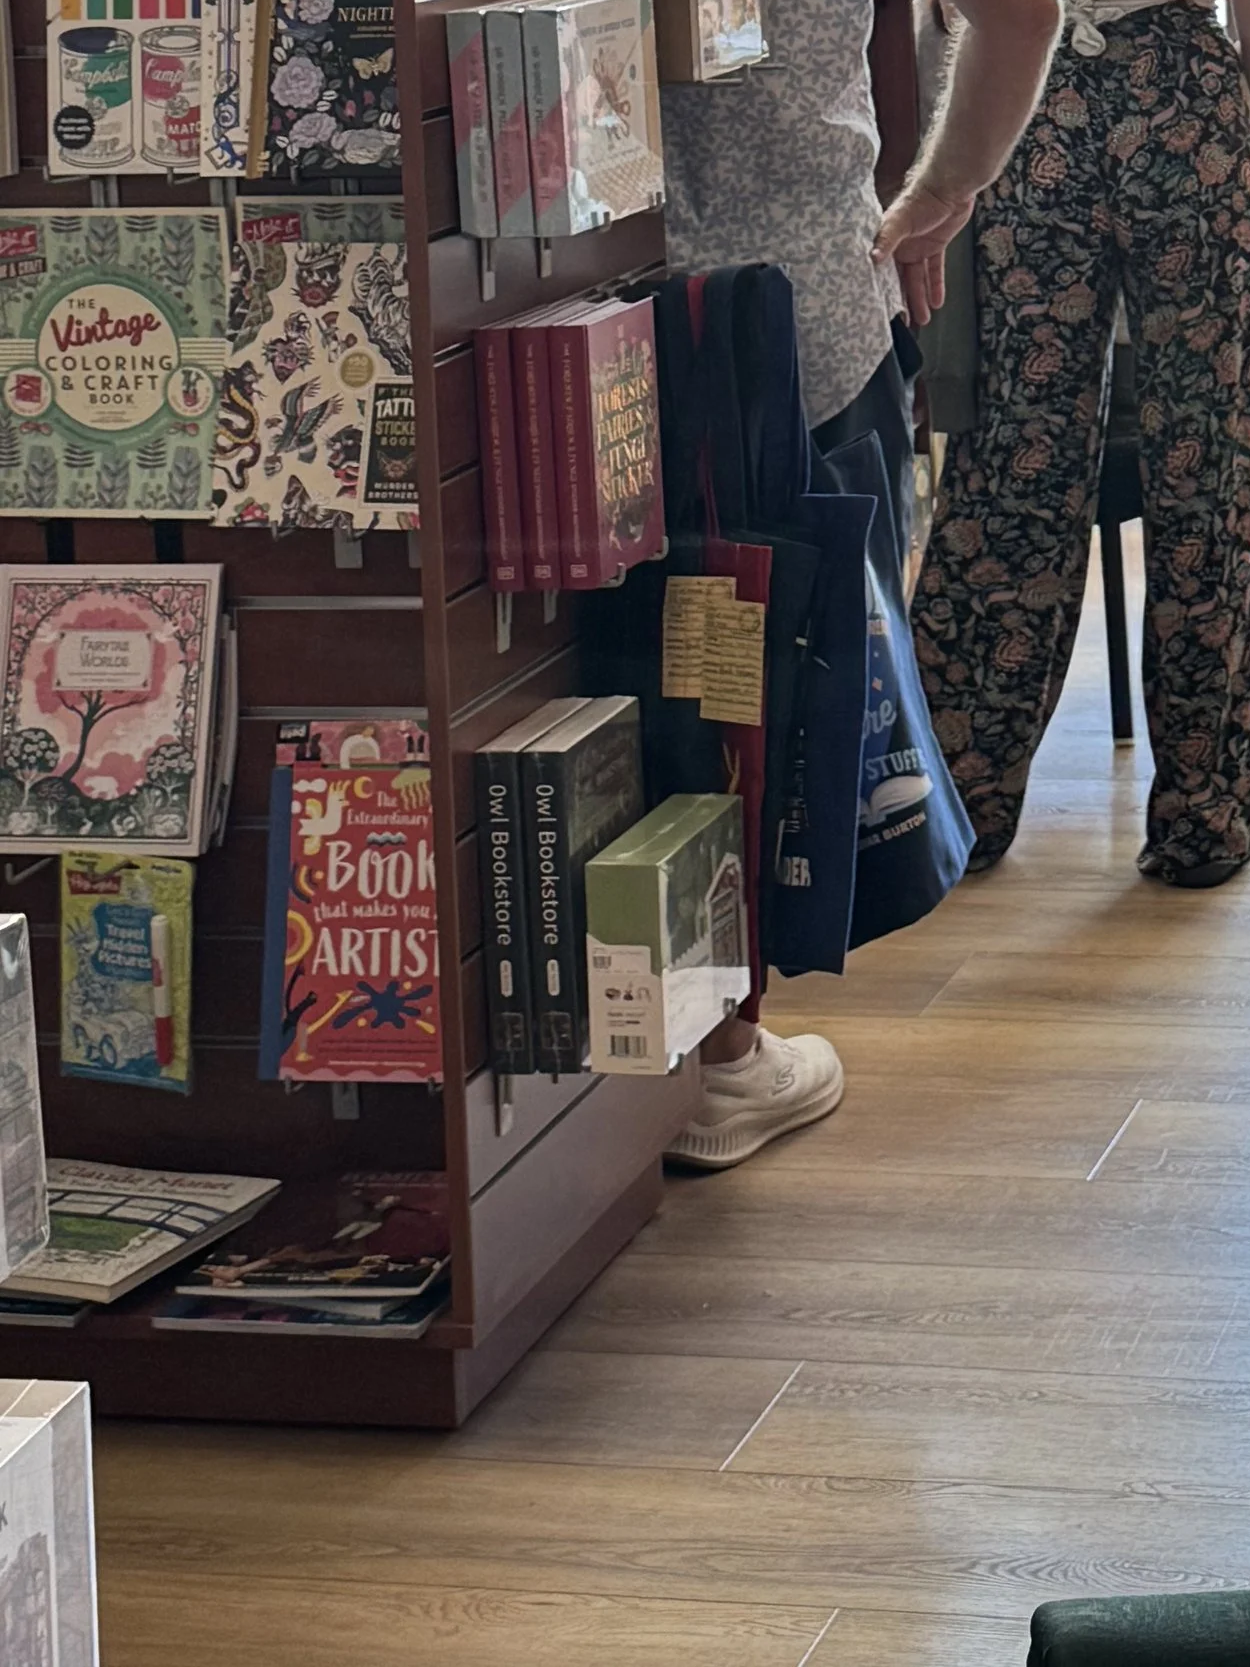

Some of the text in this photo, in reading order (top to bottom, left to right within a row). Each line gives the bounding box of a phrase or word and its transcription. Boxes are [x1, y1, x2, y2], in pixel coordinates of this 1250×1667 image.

[337, 6, 395, 22] NIGHT
[68, 298, 96, 309] THE
[50, 307, 161, 352] Vintage
[45, 355, 173, 372] COLORING
[61, 375, 159, 391] & CRAFT
[89, 393, 135, 405] BOOK
[375, 397, 416, 419] TATT
[375, 420, 416, 436] STICKE
[376, 791, 397, 807] The
[347, 808, 429, 827] Extraordinary
[325, 838, 436, 900] BOOK
[488, 784, 513, 946] Owl Bookstore
[535, 784, 561, 945] Owl Bookstore
[313, 900, 431, 923] that makes you
